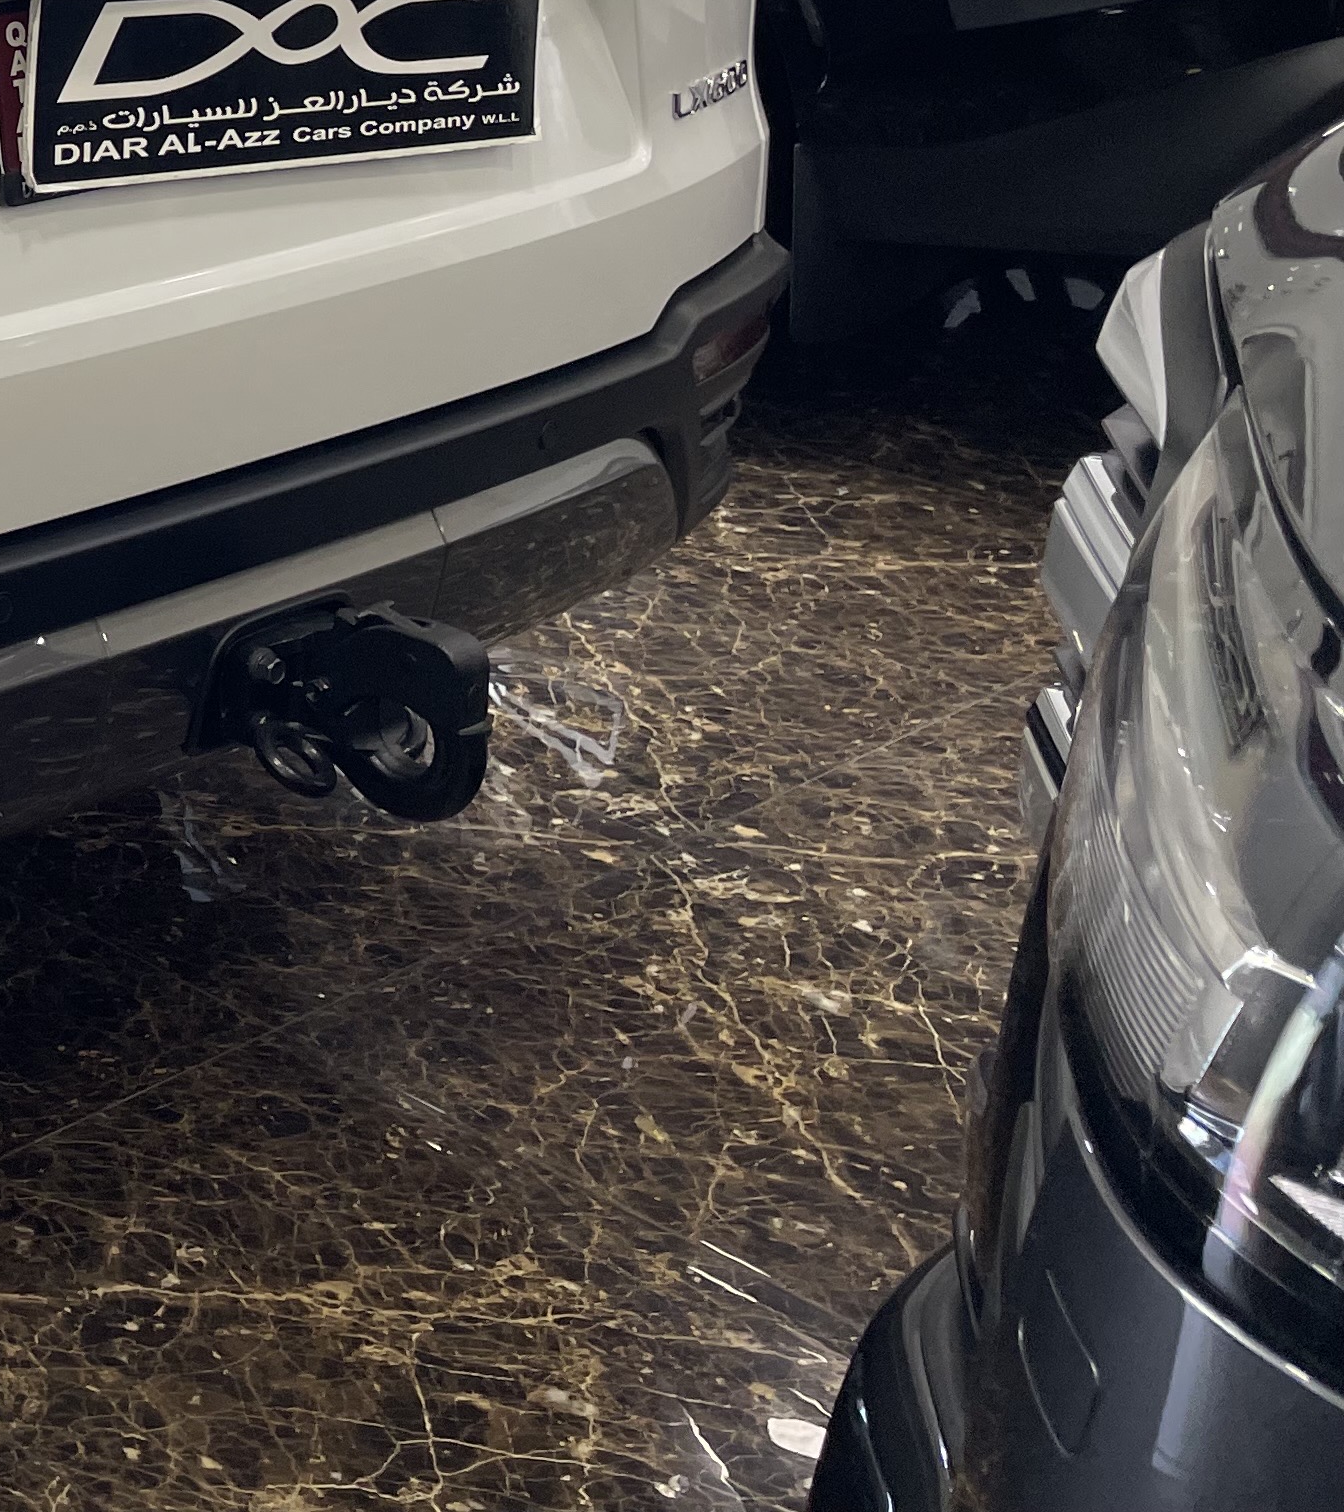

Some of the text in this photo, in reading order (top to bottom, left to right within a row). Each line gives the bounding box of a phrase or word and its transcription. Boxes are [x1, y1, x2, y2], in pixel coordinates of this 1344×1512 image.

[423, 73, 521, 103] شركة
[102, 97, 259, 132] للسيارات
[53, 136, 150, 166] DIAR
[292, 125, 352, 143] Cars
[359, 113, 476, 136] Company
